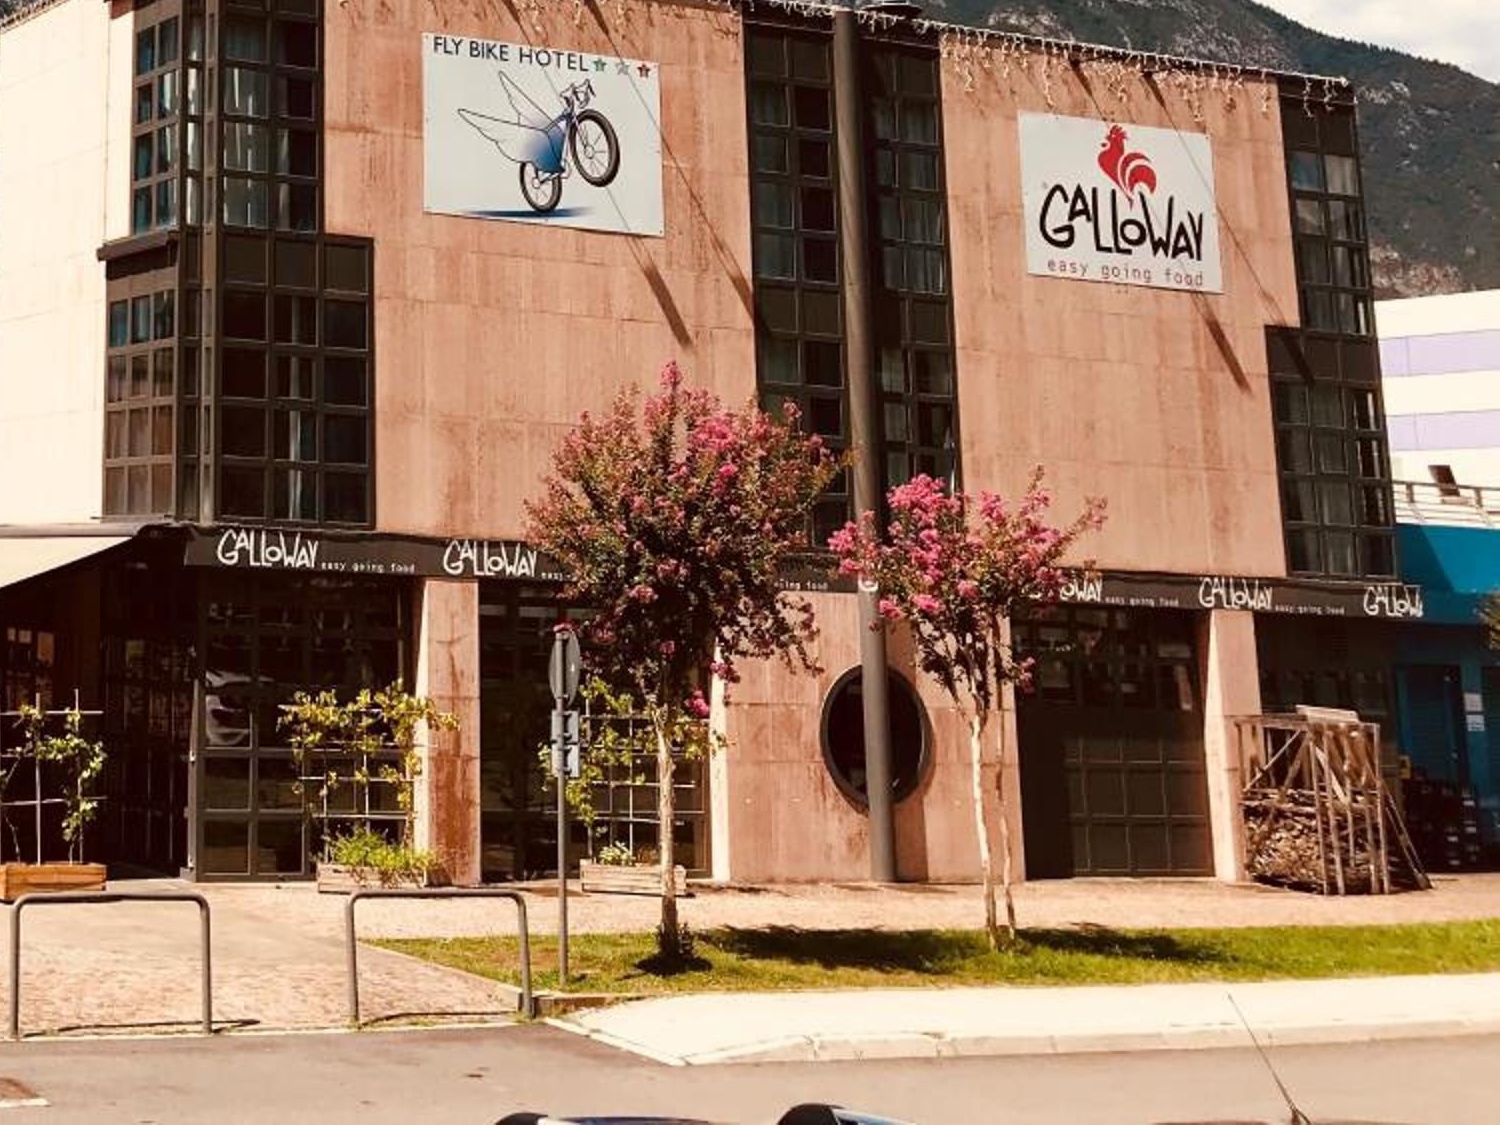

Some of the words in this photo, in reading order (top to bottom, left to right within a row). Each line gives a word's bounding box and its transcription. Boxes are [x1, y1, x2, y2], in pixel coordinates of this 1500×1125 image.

[433, 36, 463, 55] FLY
[469, 40, 509, 61] BIKE
[519, 47, 589, 72] HOTEL
[1039, 183, 1203, 261] GALLOWAY
[1047, 260, 1088, 275] easy
[1101, 264, 1152, 283] going
[1164, 268, 1203, 286] food
[217, 529, 319, 568] GALLOWAY
[390, 563, 415, 573] food
[443, 539, 537, 577] GALLOWAY
[1198, 577, 1273, 610] GALLOWAY
